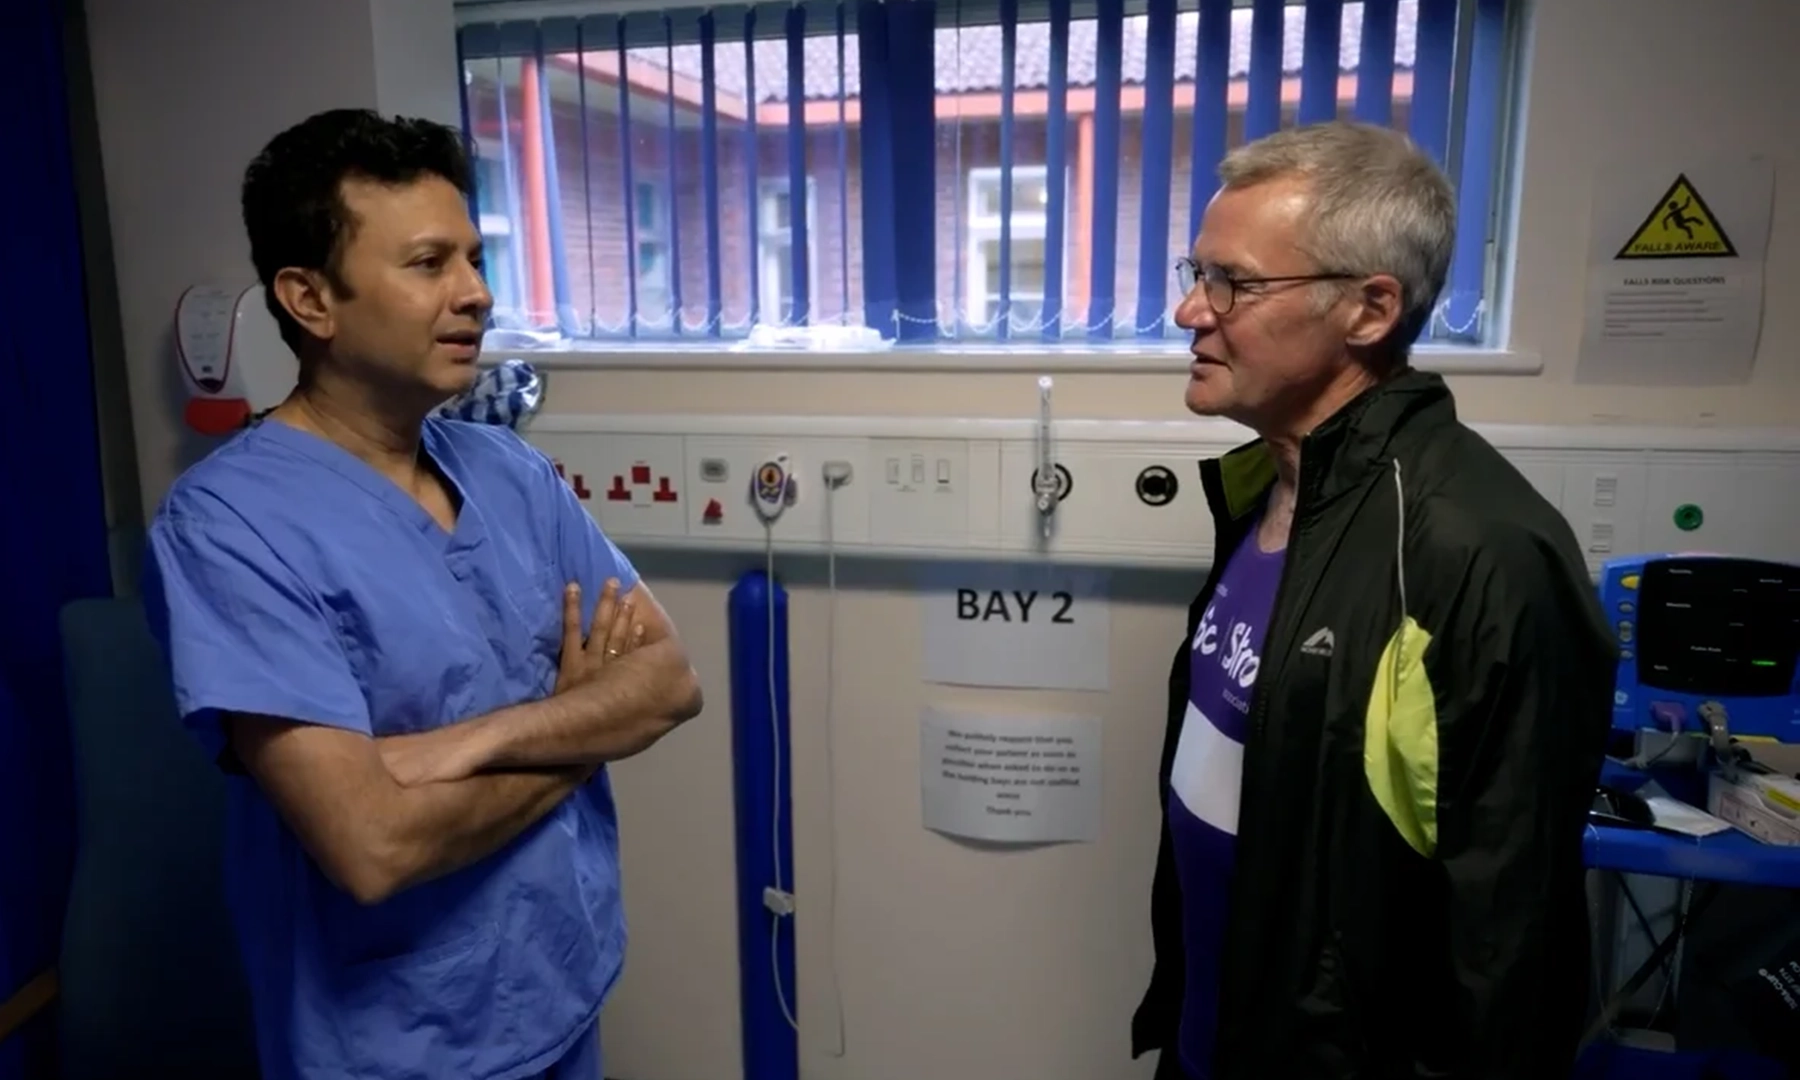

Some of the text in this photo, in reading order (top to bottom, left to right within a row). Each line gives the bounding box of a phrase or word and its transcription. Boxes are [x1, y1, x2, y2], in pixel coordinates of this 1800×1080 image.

[1634, 241, 1721, 252] FALLS AWARE
[1623, 275, 1726, 286] FALLS RISK QUESTIONS
[957, 588, 1075, 624] BAY 2
